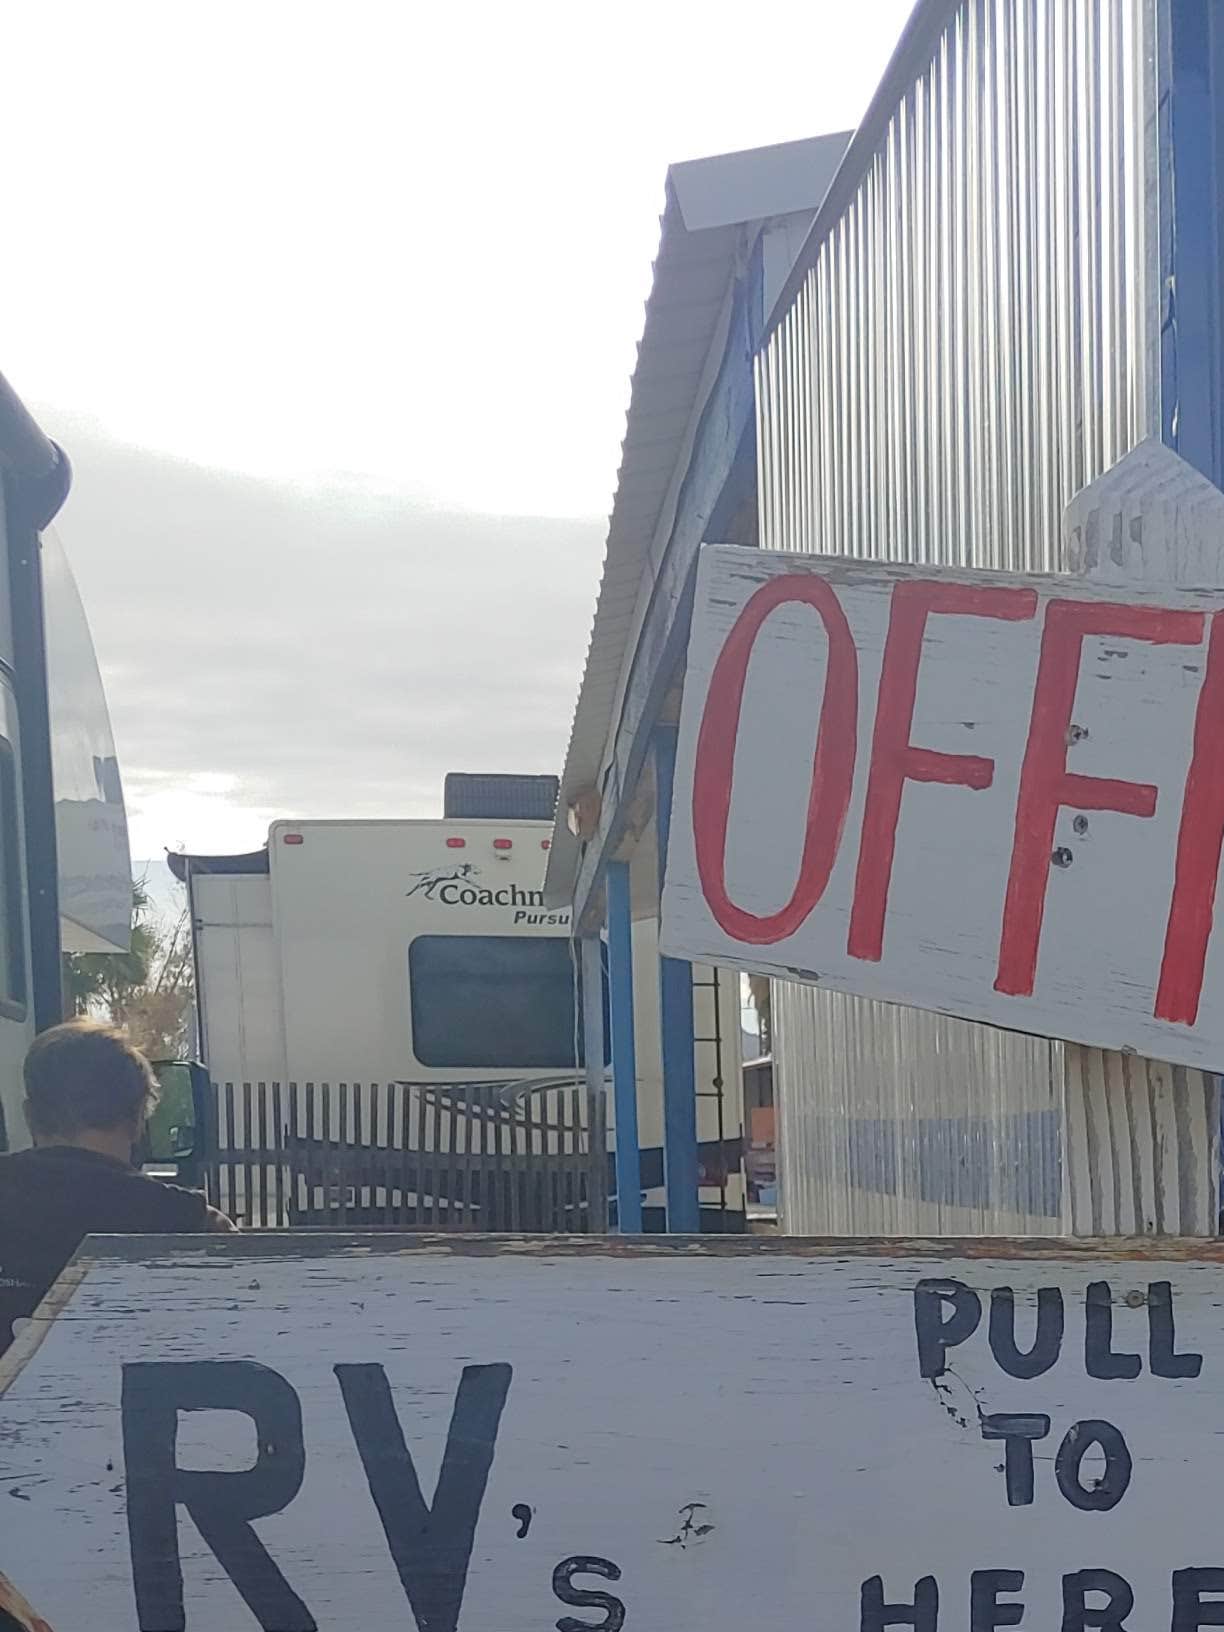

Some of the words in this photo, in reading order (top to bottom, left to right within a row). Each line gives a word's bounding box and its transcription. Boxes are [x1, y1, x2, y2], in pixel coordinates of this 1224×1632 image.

[513, 910, 570, 925] Pursu
[915, 1278, 1204, 1381] PULL
[981, 1411, 1133, 1512] TO
